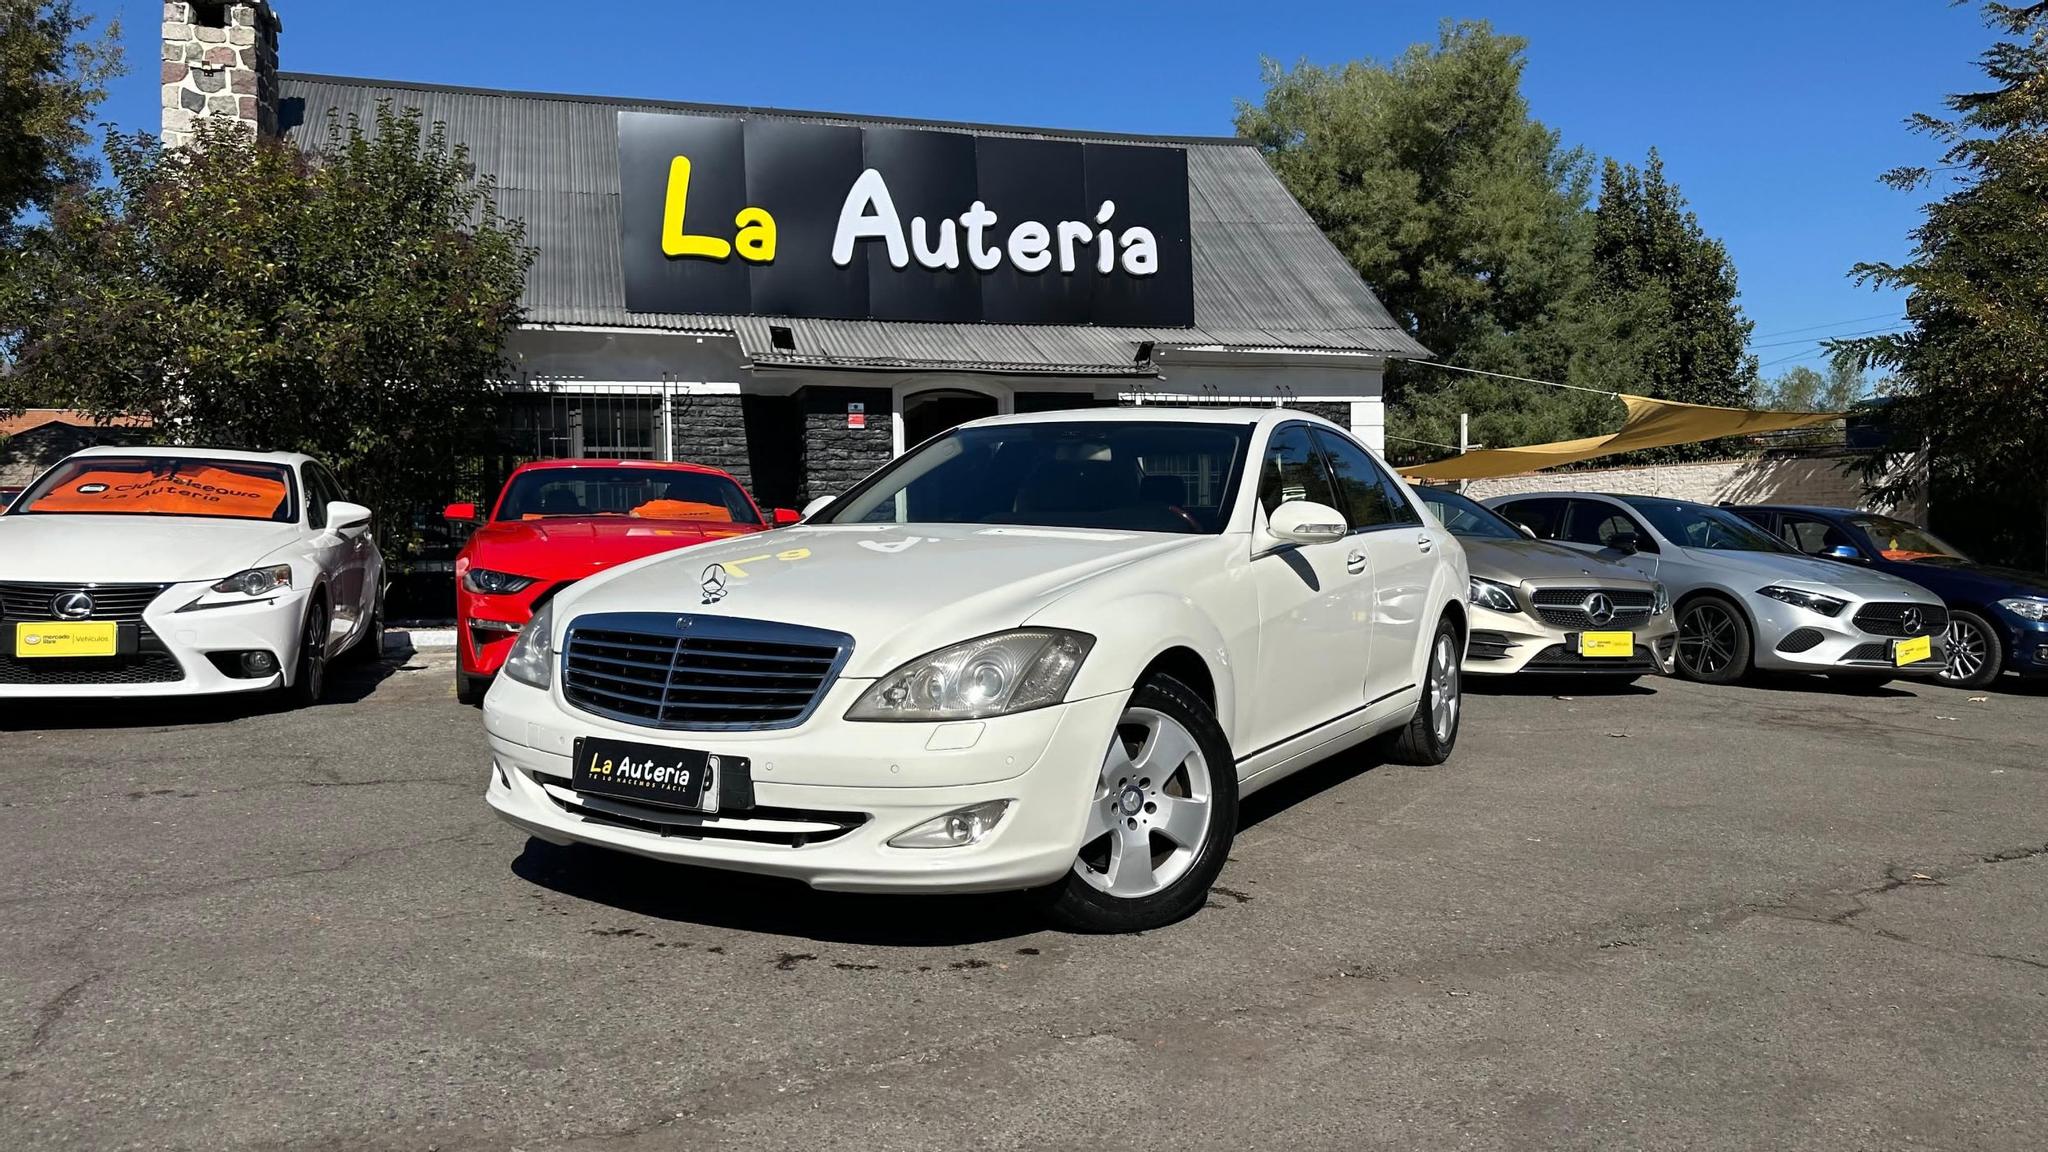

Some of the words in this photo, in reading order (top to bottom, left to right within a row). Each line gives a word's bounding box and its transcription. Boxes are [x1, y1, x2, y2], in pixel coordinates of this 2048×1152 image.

[662, 155, 777, 261] La
[831, 168, 1158, 275] Autería
[590, 752, 613, 775] La
[616, 756, 690, 786] Autería
[616, 778, 656, 789] HACEMOS
